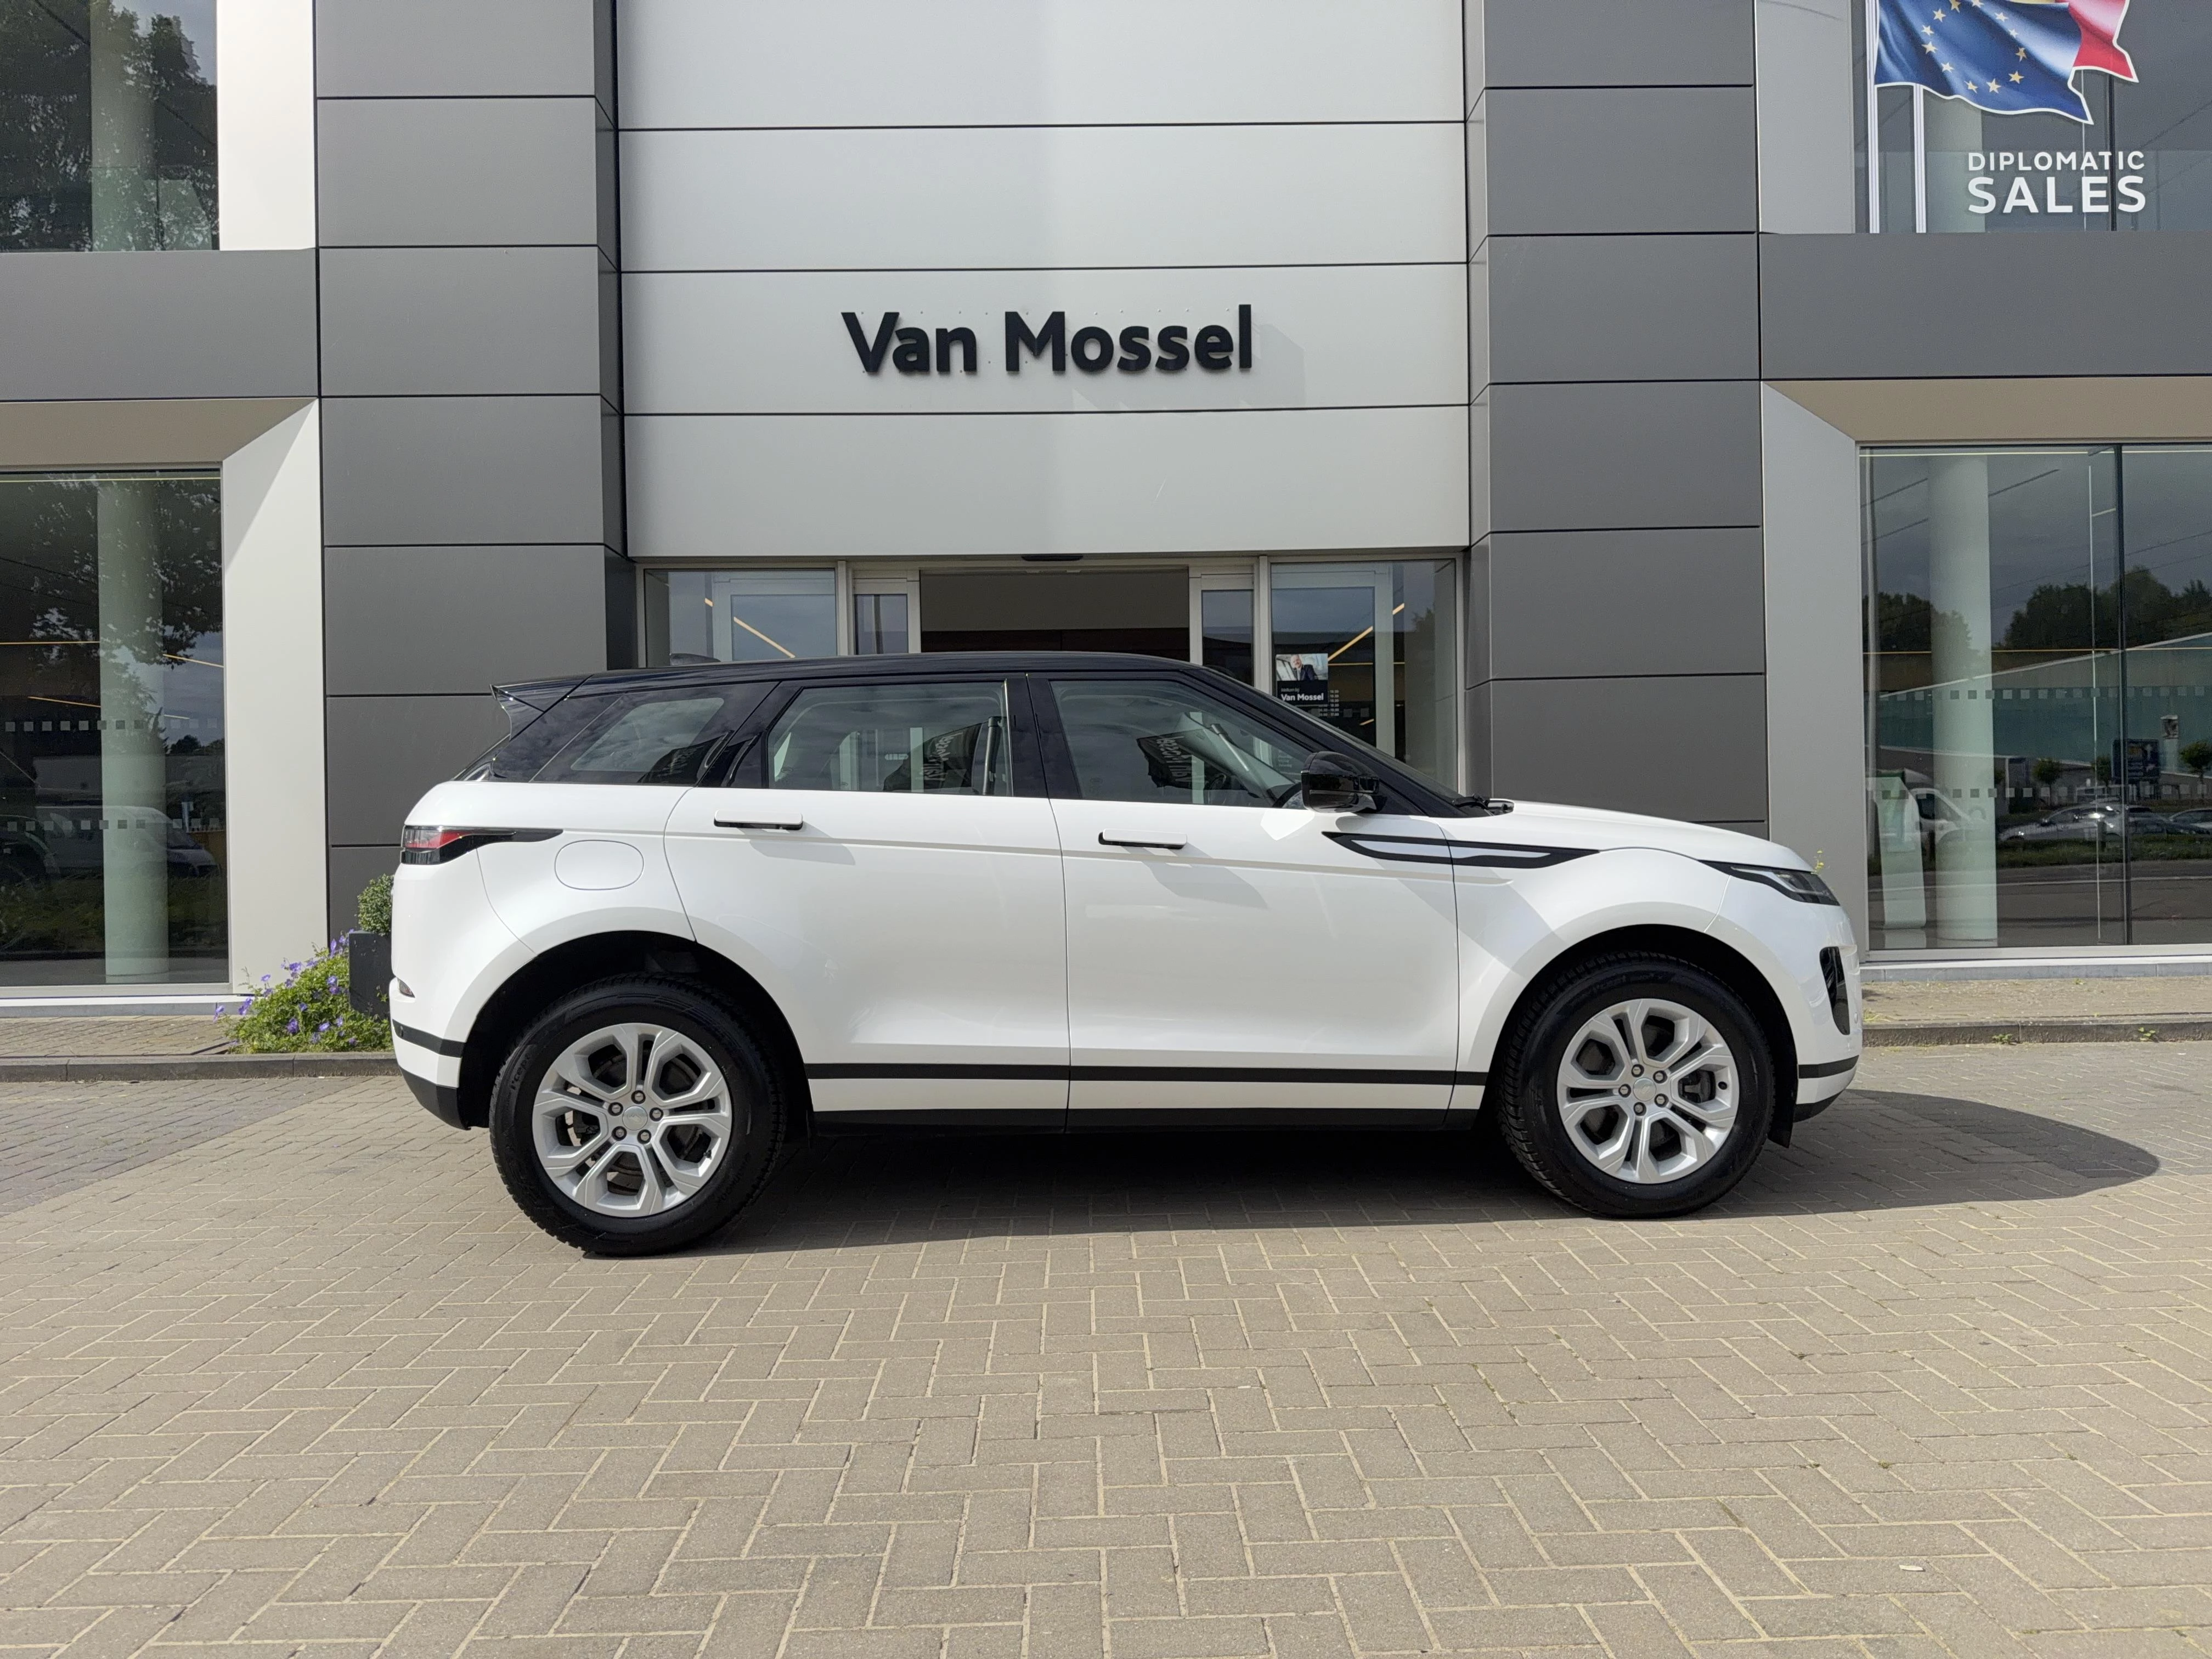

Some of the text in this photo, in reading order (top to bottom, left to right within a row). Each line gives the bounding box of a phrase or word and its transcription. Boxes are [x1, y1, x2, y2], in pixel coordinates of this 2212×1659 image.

[1968, 151, 2145, 171] DIPLOMATIC
[1967, 175, 2146, 214] SALES
[840, 304, 1252, 373] Van Mossel
[1297, 692, 1324, 701] Mossel
